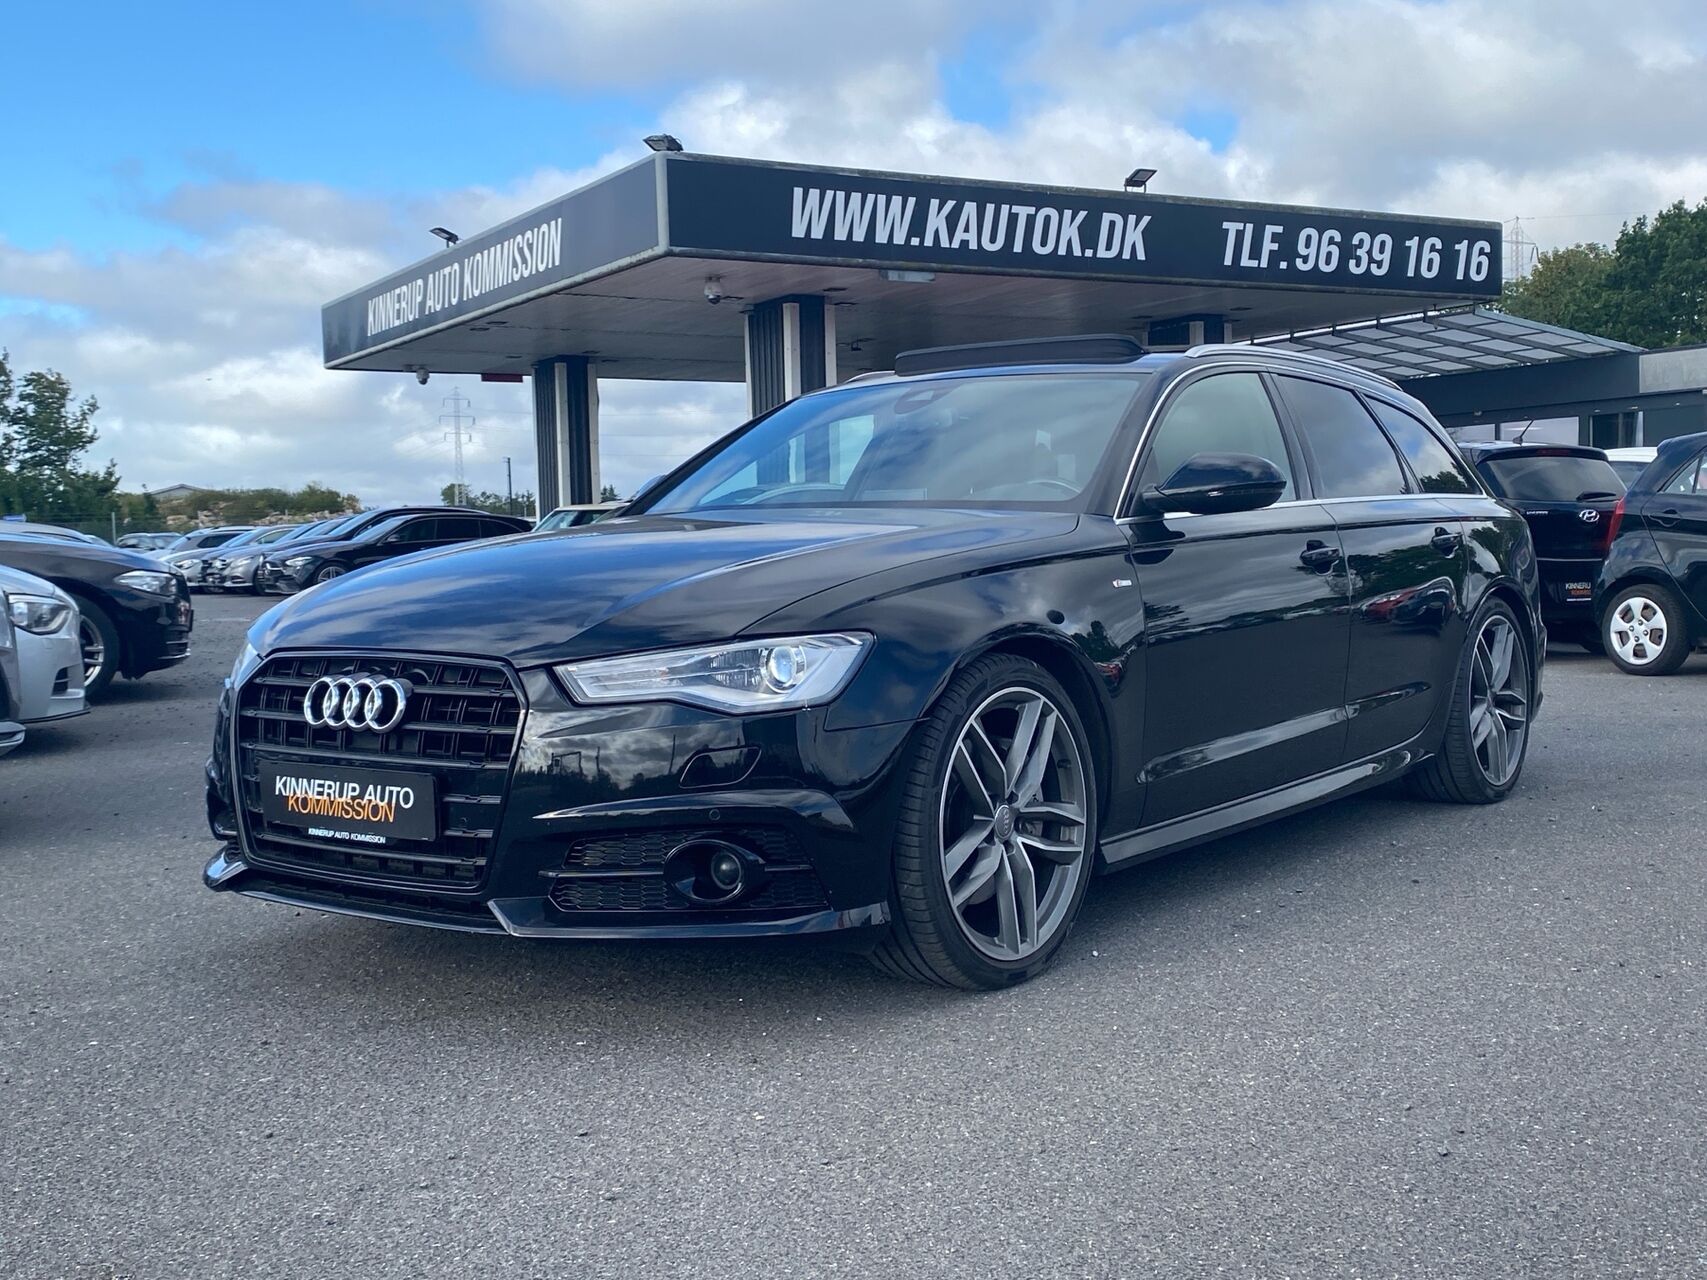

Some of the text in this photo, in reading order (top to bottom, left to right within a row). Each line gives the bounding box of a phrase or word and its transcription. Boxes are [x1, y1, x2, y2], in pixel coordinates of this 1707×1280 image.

[790, 186, 1153, 262] WWW.KAUTOK.DK
[1222, 220, 1491, 283] TLF. 96 39 16 16
[367, 217, 562, 337] KINNERUP AUTO KOMMISSION
[1565, 582, 1591, 590] KINNERU
[275, 775, 414, 809] KINNERUP AUTO
[288, 795, 395, 822] KOMMISSION
[308, 827, 386, 844] KINNERUP AUTO KOMMISSION
